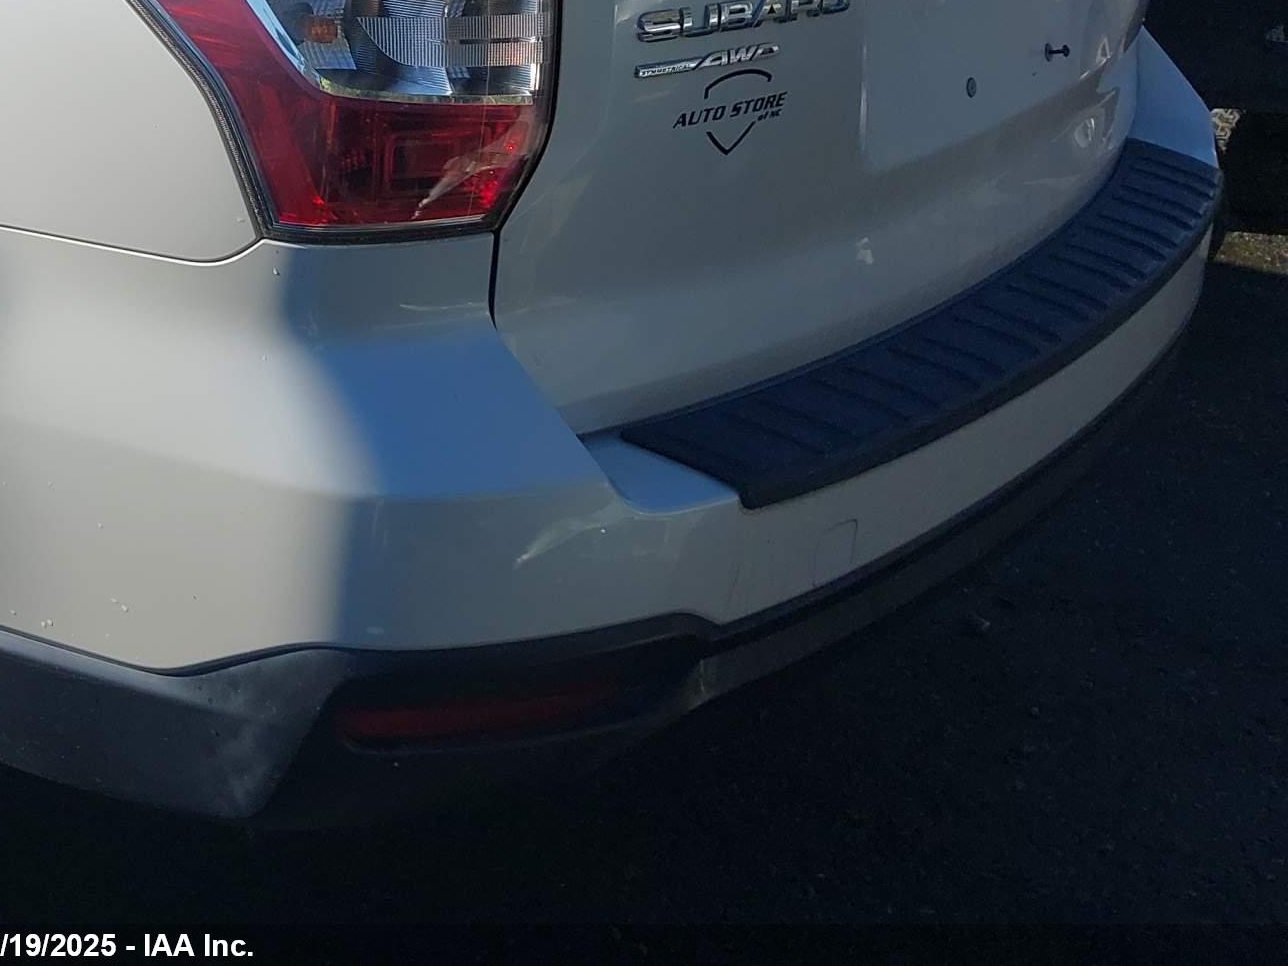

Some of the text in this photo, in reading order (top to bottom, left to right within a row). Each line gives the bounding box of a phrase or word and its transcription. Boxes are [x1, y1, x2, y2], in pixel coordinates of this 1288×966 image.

[695, 42, 779, 68] AWD
[673, 91, 788, 128] AUTO STORE
